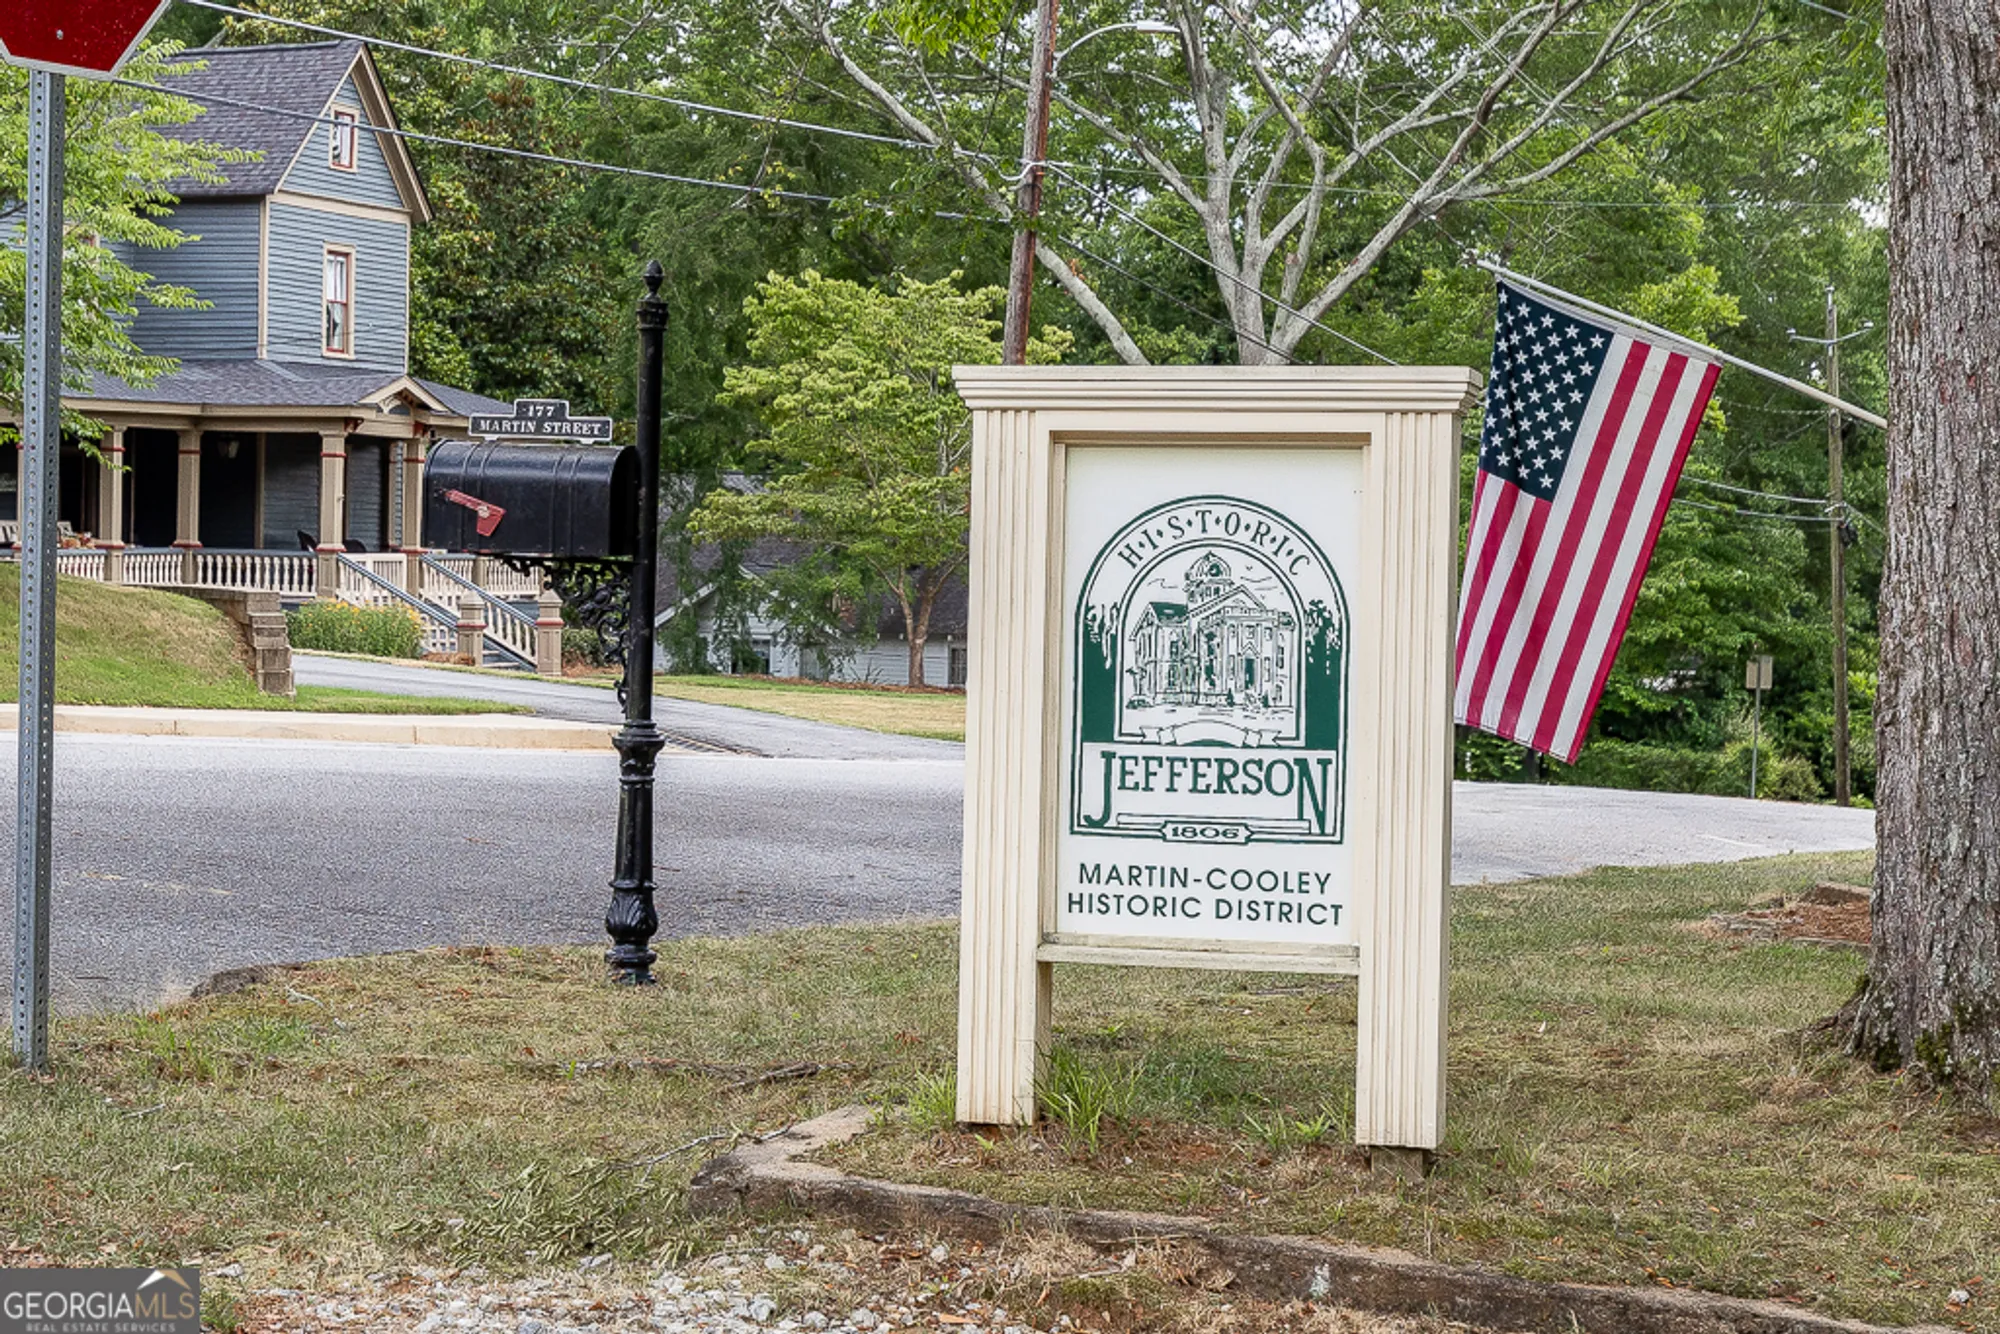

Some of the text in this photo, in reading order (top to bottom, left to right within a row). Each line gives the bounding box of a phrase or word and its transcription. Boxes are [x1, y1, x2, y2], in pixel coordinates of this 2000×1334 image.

[526, 405, 555, 418] 177
[478, 419, 603, 435] MARTIN STREET
[1083, 751, 1333, 834] JEFFERSON
[1171, 826, 1240, 839] 1806
[1079, 863, 1332, 894] MARTIN-COOLEY
[1068, 892, 1343, 926] HISTORIC DISTRICT
